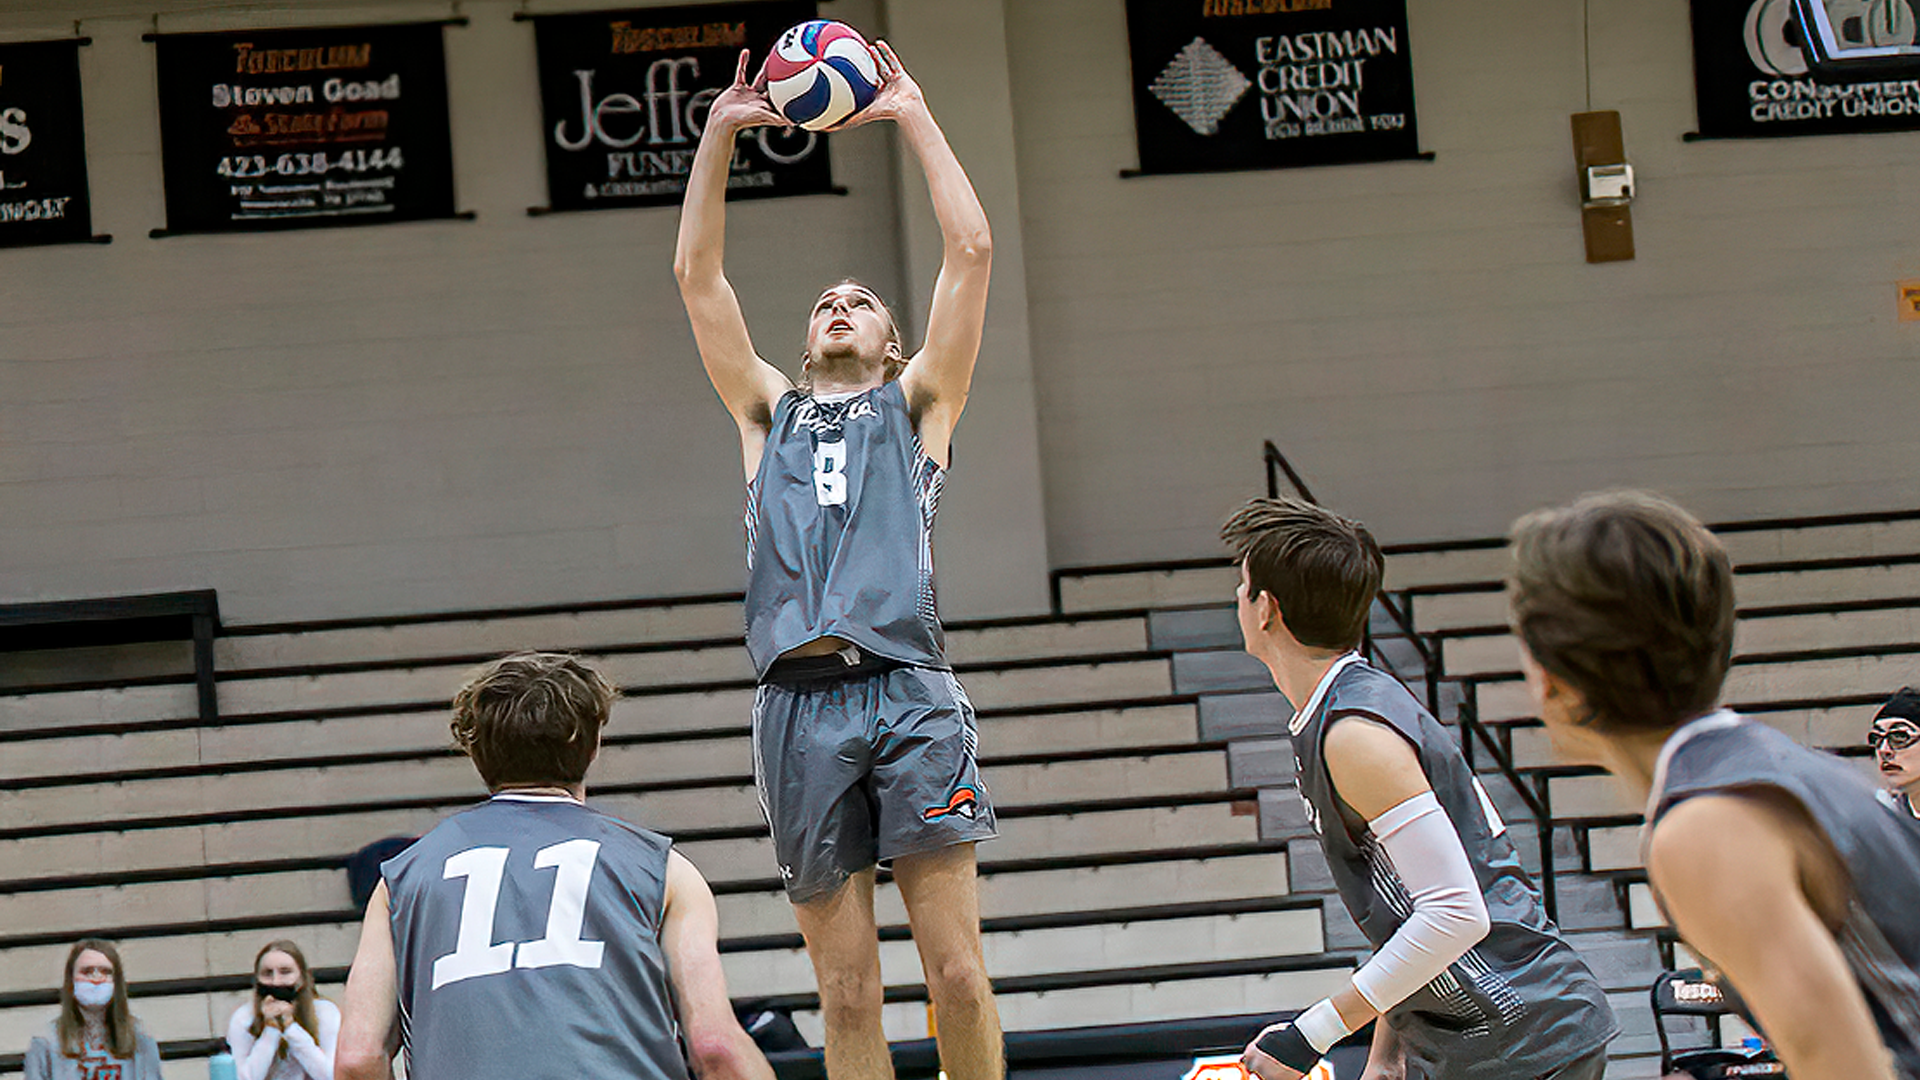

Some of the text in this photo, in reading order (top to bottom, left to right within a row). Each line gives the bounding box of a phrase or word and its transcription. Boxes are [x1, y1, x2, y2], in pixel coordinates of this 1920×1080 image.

[1255, 27, 1396, 64] EASTMAN
[212, 73, 400, 107] Steven Goad
[1257, 59, 1366, 93] CREDIT
[1260, 90, 1360, 122] UNION
[1842, 94, 1920, 118] UNION
[217, 147, 404, 178] 423-638-4144
[607, 147, 751, 178] FUNEL
[813, 439, 849, 506] 8
[432, 839, 606, 991] 11
